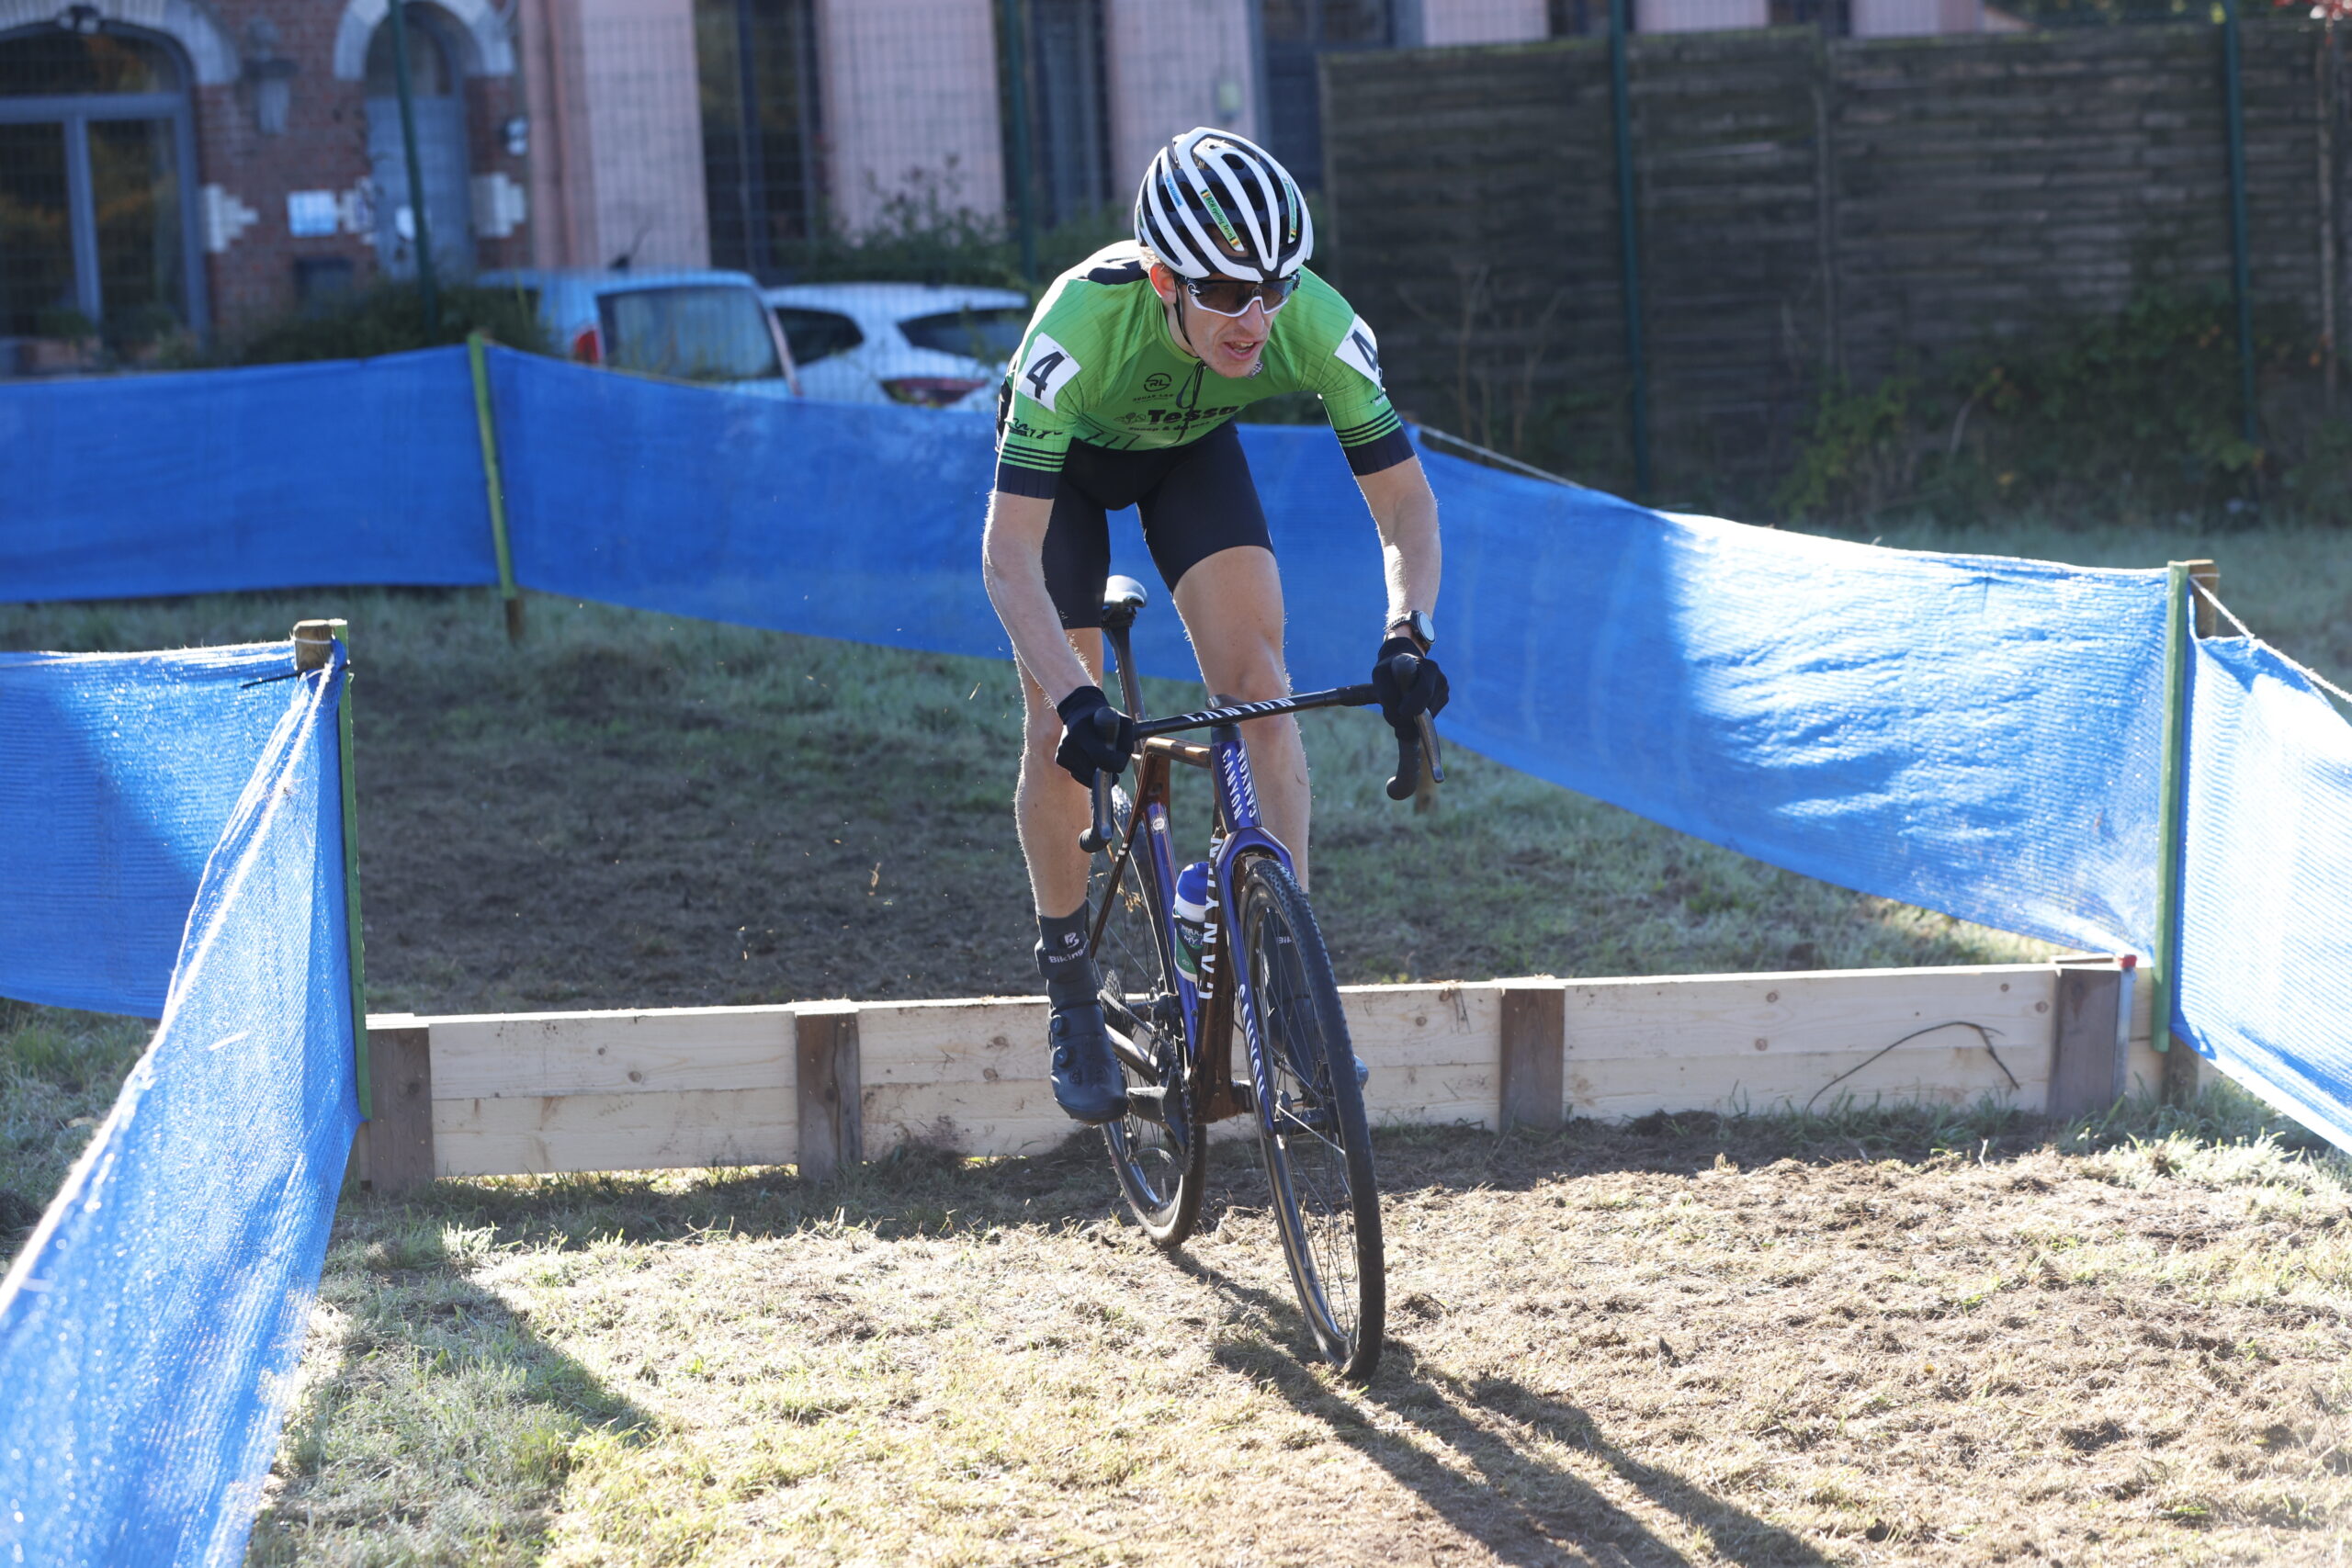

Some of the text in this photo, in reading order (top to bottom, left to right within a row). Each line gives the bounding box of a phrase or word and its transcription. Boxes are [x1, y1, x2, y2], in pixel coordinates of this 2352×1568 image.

[1026, 351, 1065, 400] 4
[1181, 698, 1295, 722] CANYON
[1223, 749, 1243, 820] CANYON
[1238, 748, 1257, 818] CANYON
[1048, 949, 1084, 964] Biking
[1184, 935, 1198, 944] MY
[1238, 984, 1264, 1102] CANYON
